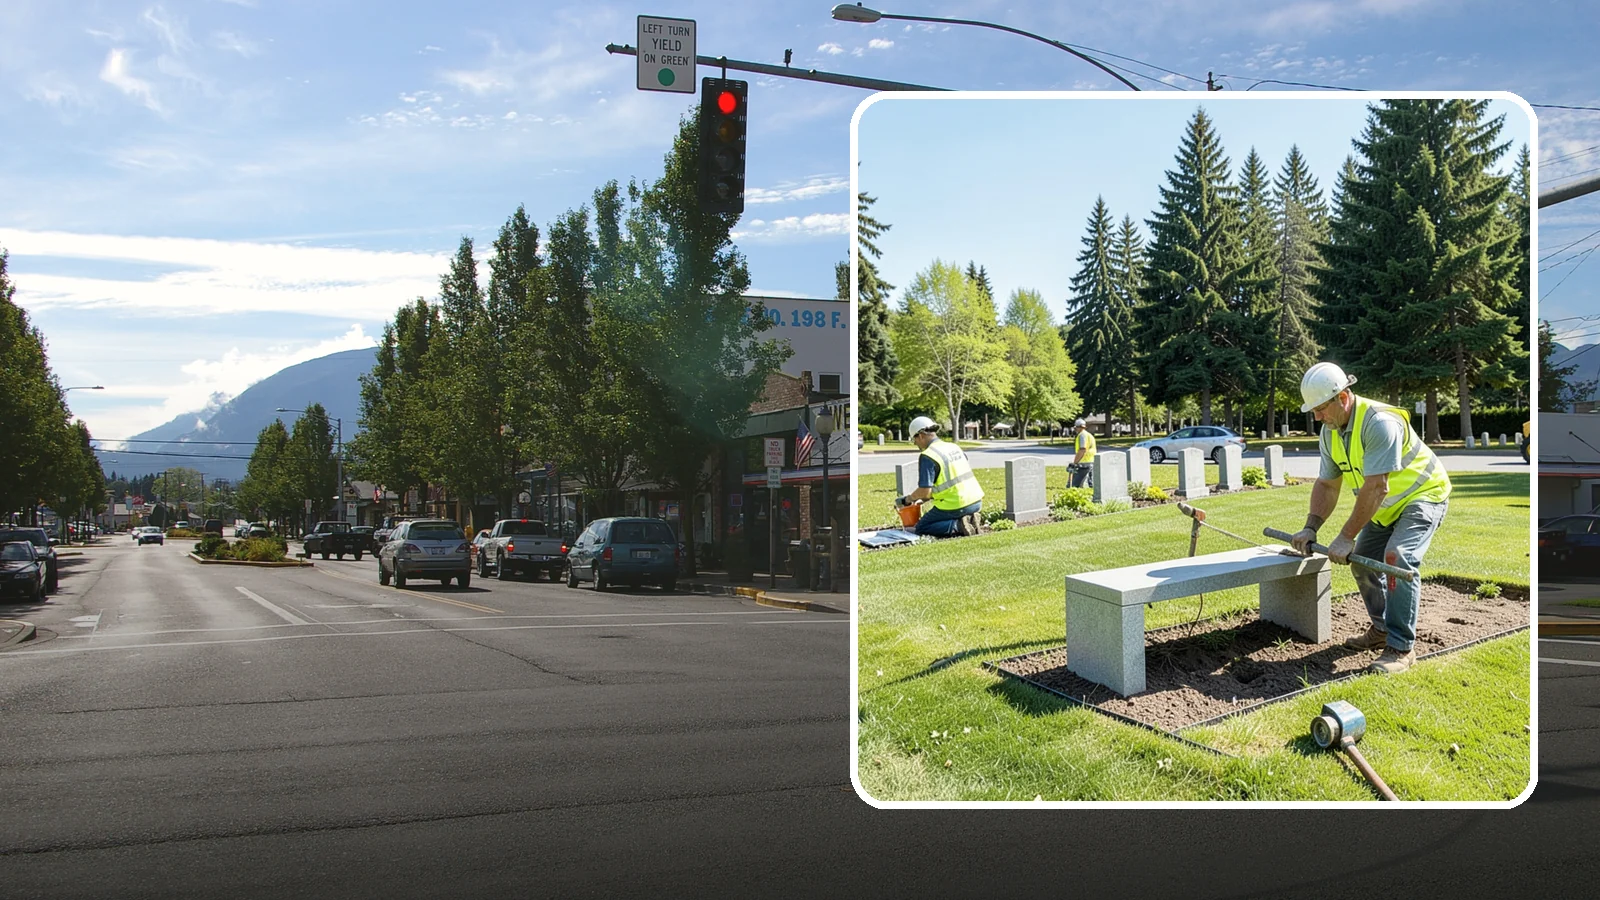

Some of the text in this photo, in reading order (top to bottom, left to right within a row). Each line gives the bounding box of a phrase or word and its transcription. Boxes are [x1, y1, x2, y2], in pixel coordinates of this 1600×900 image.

[643, 23, 690, 36] LEFT TURN
[652, 38, 682, 51] YIELD
[644, 53, 688, 66] ON GREEN
[791, 309, 826, 328] 198
[831, 311, 847, 329] F.
